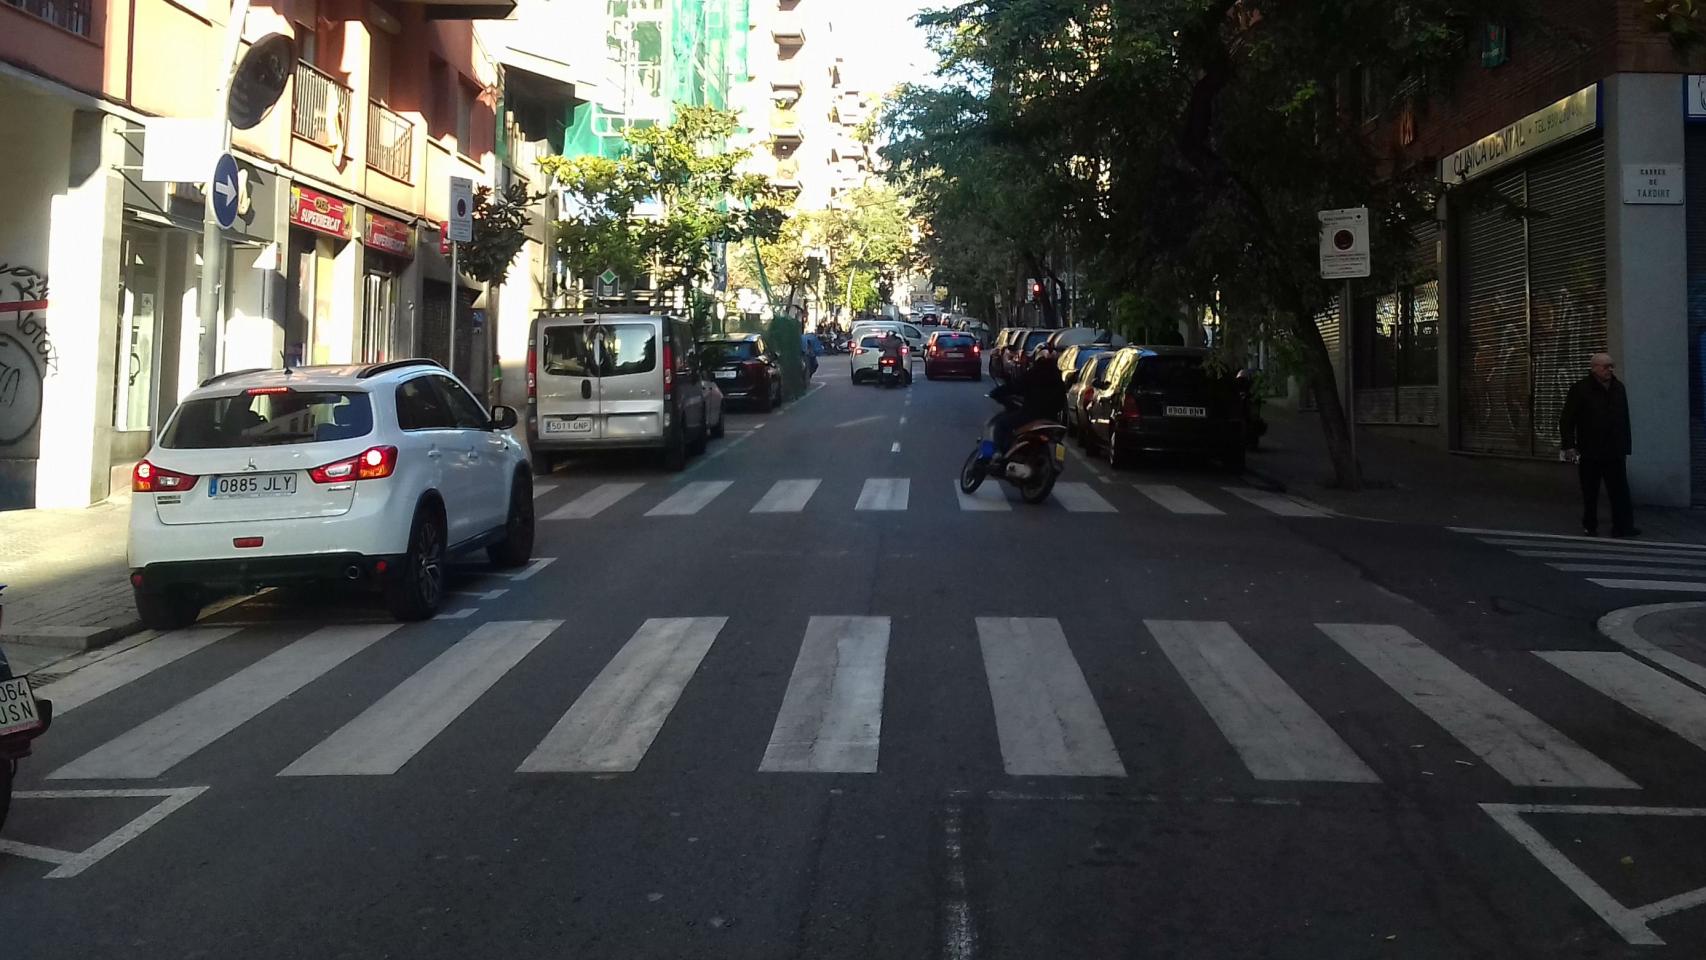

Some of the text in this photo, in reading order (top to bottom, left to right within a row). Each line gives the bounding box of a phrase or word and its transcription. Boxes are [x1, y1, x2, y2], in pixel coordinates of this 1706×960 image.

[1489, 123, 1526, 161] DENTAL
[1648, 178, 1658, 186] DE
[301, 208, 341, 231] SUPERMERCAT
[219, 475, 292, 493] 0885 JLY
